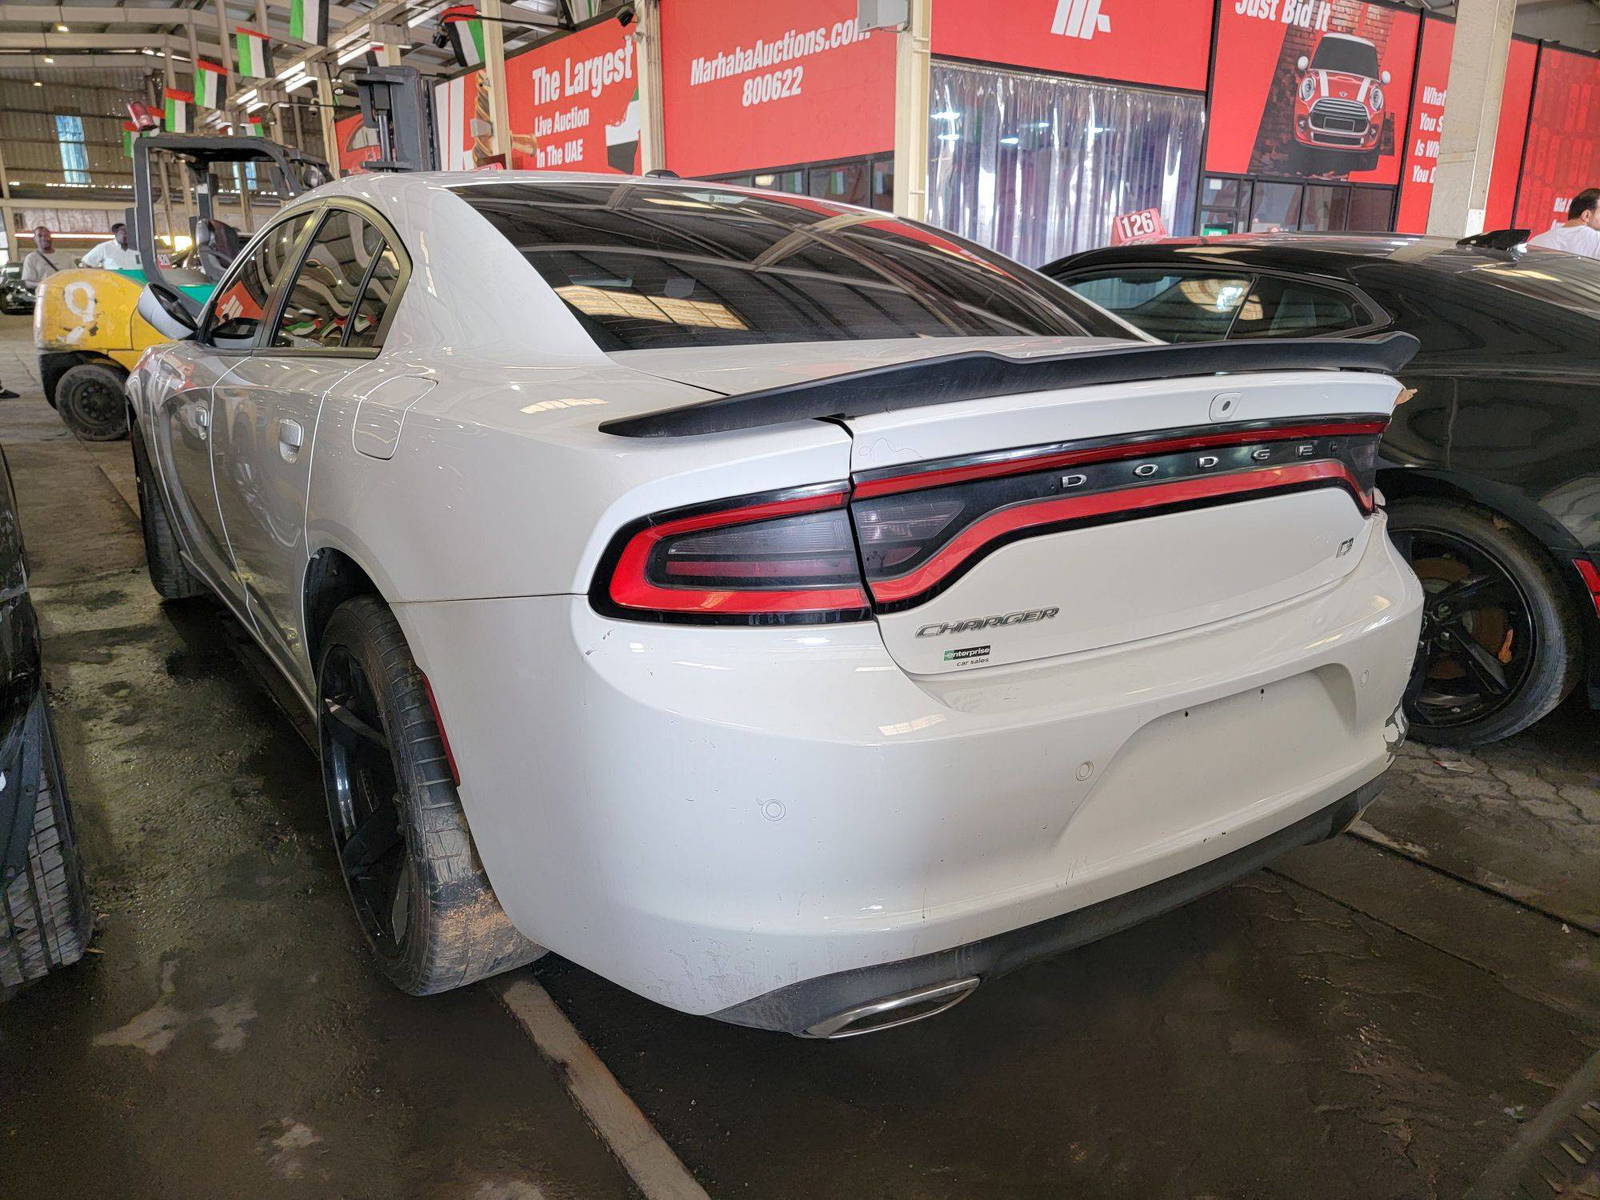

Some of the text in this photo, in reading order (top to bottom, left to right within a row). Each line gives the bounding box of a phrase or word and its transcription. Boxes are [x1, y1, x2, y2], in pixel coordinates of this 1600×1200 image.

[1235, 0, 1331, 32] Just Bid It
[532, 35, 634, 106] The Largest
[741, 66, 804, 107] 800622
[1422, 86, 1447, 107] What
[535, 105, 590, 138] Live Auction
[1419, 112, 1436, 132] You
[536, 138, 583, 169] In The UAE
[1414, 139, 1425, 157] Is
[1411, 164, 1429, 184] You
[1121, 212, 1155, 238] 126
[1061, 444, 1314, 488] DODGE
[915, 606, 1061, 639] CHARGER
[945, 647, 991, 660] enterprise
[970, 657, 989, 665] sales
